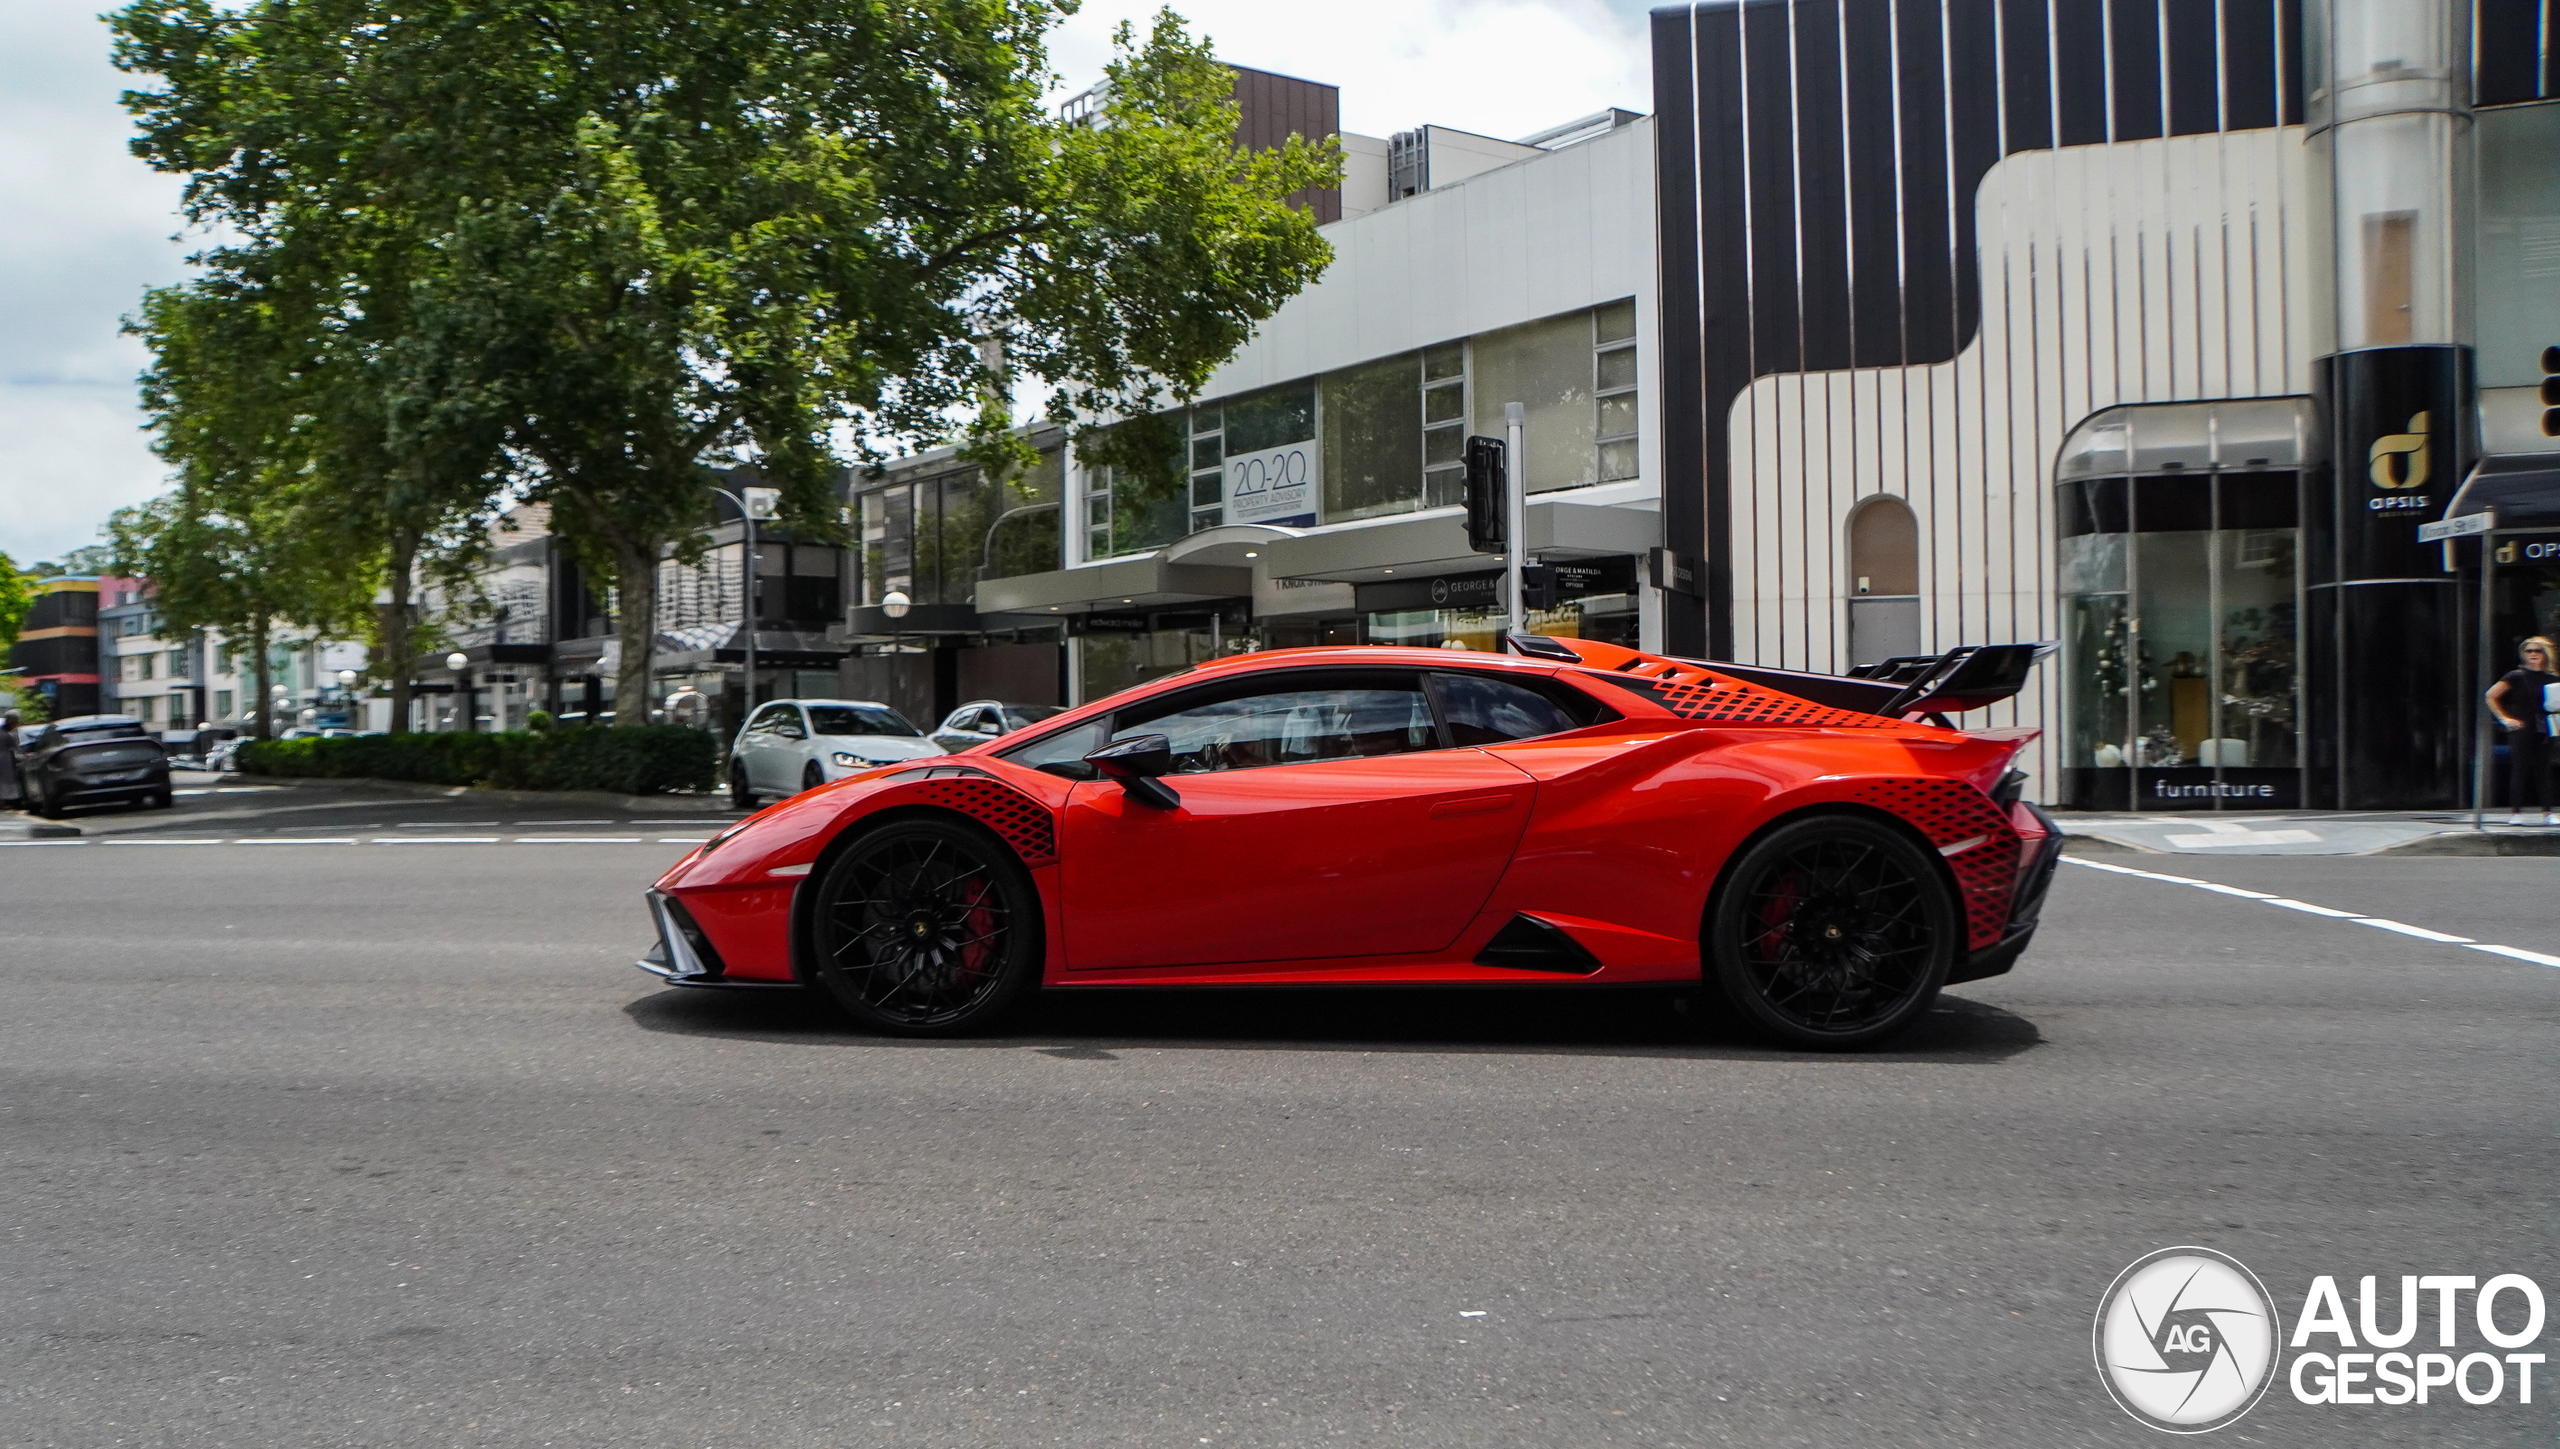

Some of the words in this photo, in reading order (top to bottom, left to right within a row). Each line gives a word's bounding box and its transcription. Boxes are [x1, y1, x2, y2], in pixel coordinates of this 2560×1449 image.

[1234, 450, 1306, 497] 20-20
[1233, 494, 1269, 509] PROPERTY
[1270, 488, 1306, 504] ADVISORY
[2369, 495, 2430, 510] OPSIS
[2525, 543, 2560, 558] OP
[1556, 566, 1571, 574] ORGE
[1577, 567, 1602, 575] MATILDA
[1451, 581, 1488, 592] GEORGE
[1489, 580, 1495, 589] &
[2155, 779, 2275, 797] furniture
